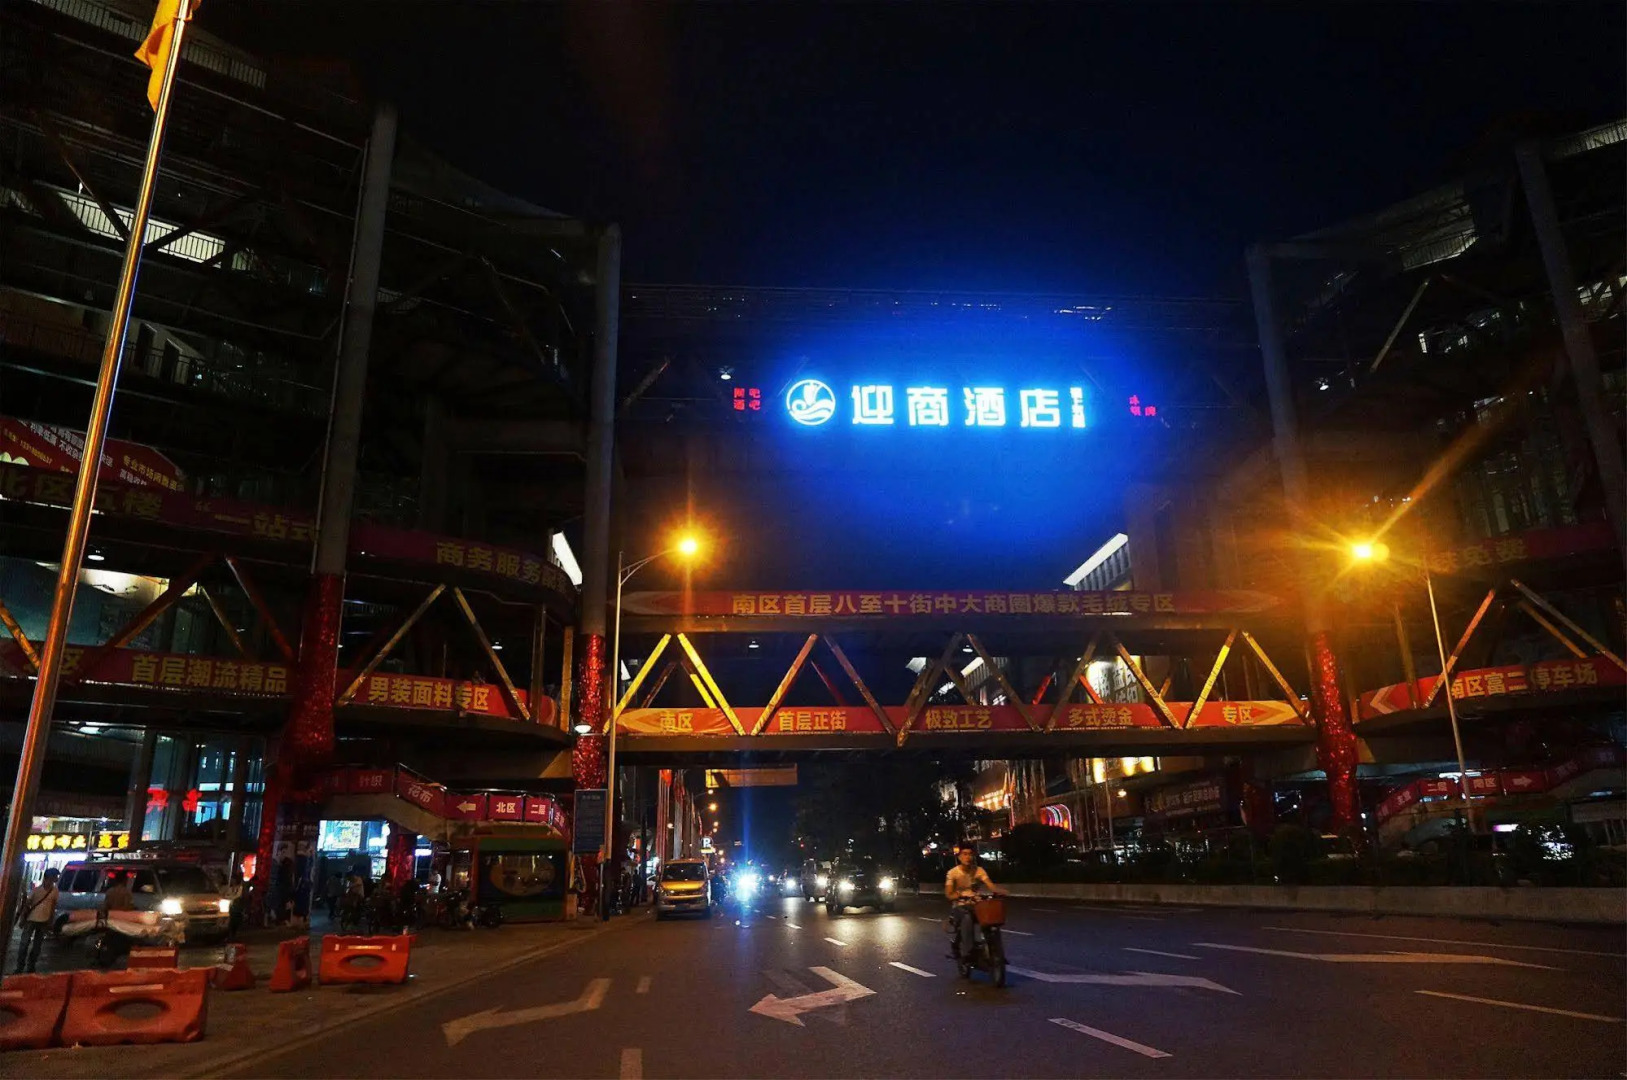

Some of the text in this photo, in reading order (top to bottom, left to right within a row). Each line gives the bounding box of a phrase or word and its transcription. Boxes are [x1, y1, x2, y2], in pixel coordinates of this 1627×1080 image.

[851, 385, 1060, 427] 迎商酒店
[131, 655, 287, 693] 首层潮流精品
[367, 676, 490, 711] 男装面料专区
[660, 711, 694, 732] 南区
[778, 710, 847, 731] 首层正街
[925, 708, 992, 730] 极致工艺
[1221, 705, 1255, 725] 专区
[496, 802, 516, 814] 北区
